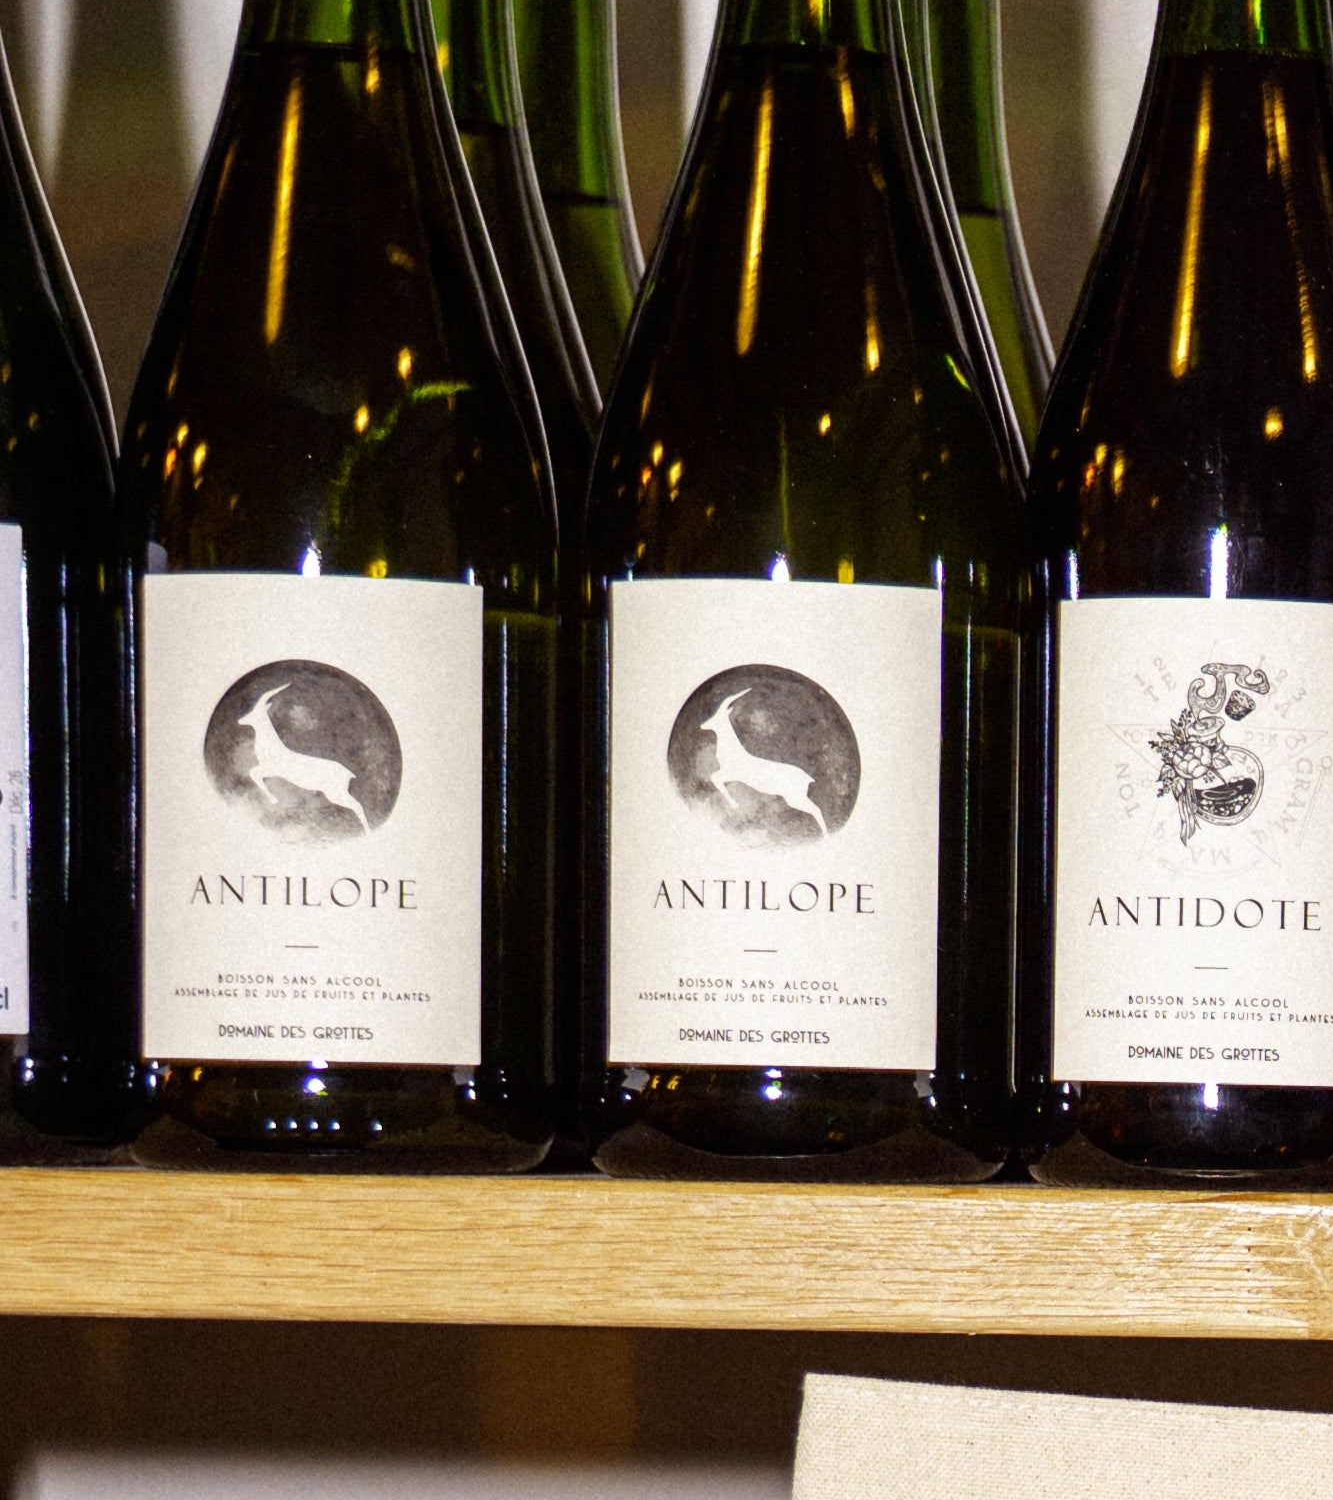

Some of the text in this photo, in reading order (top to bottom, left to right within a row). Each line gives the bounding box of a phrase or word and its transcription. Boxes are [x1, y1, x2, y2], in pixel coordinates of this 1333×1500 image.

[190, 874, 418, 910] ANTILOPE
[653, 879, 875, 914] ANTILOPE
[1088, 896, 1321, 931] ANTIDOTE
[217, 974, 382, 987] BOISSON SANS ALCOOL
[679, 978, 839, 992] BOISSON SANS ALCOOL
[174, 988, 431, 1003] ASSEMBLAGE DE JUS DE FRUITS ET PLANTES
[638, 991, 888, 1006] ASSEMBLAGE DE JUS DE FRUITS ET PLANTES
[1128, 995, 1289, 1009] BOISSON SANS ALCOOL
[1085, 1008, 1149, 1019] ASSEMBLAGE
[1155, 1010, 1168, 1019] DE
[1175, 1010, 1196, 1020] JUS
[1202, 1011, 1215, 1020] DE
[1223, 1011, 1263, 1022] FRUITS
[1269, 1013, 1282, 1022] ET
[218, 1024, 374, 1040] DOMAINE DES GROTTES
[679, 1028, 830, 1045] DOMAINE DES GROTTES
[1128, 1046, 1280, 1062] DOMAINE DES GROTTES
